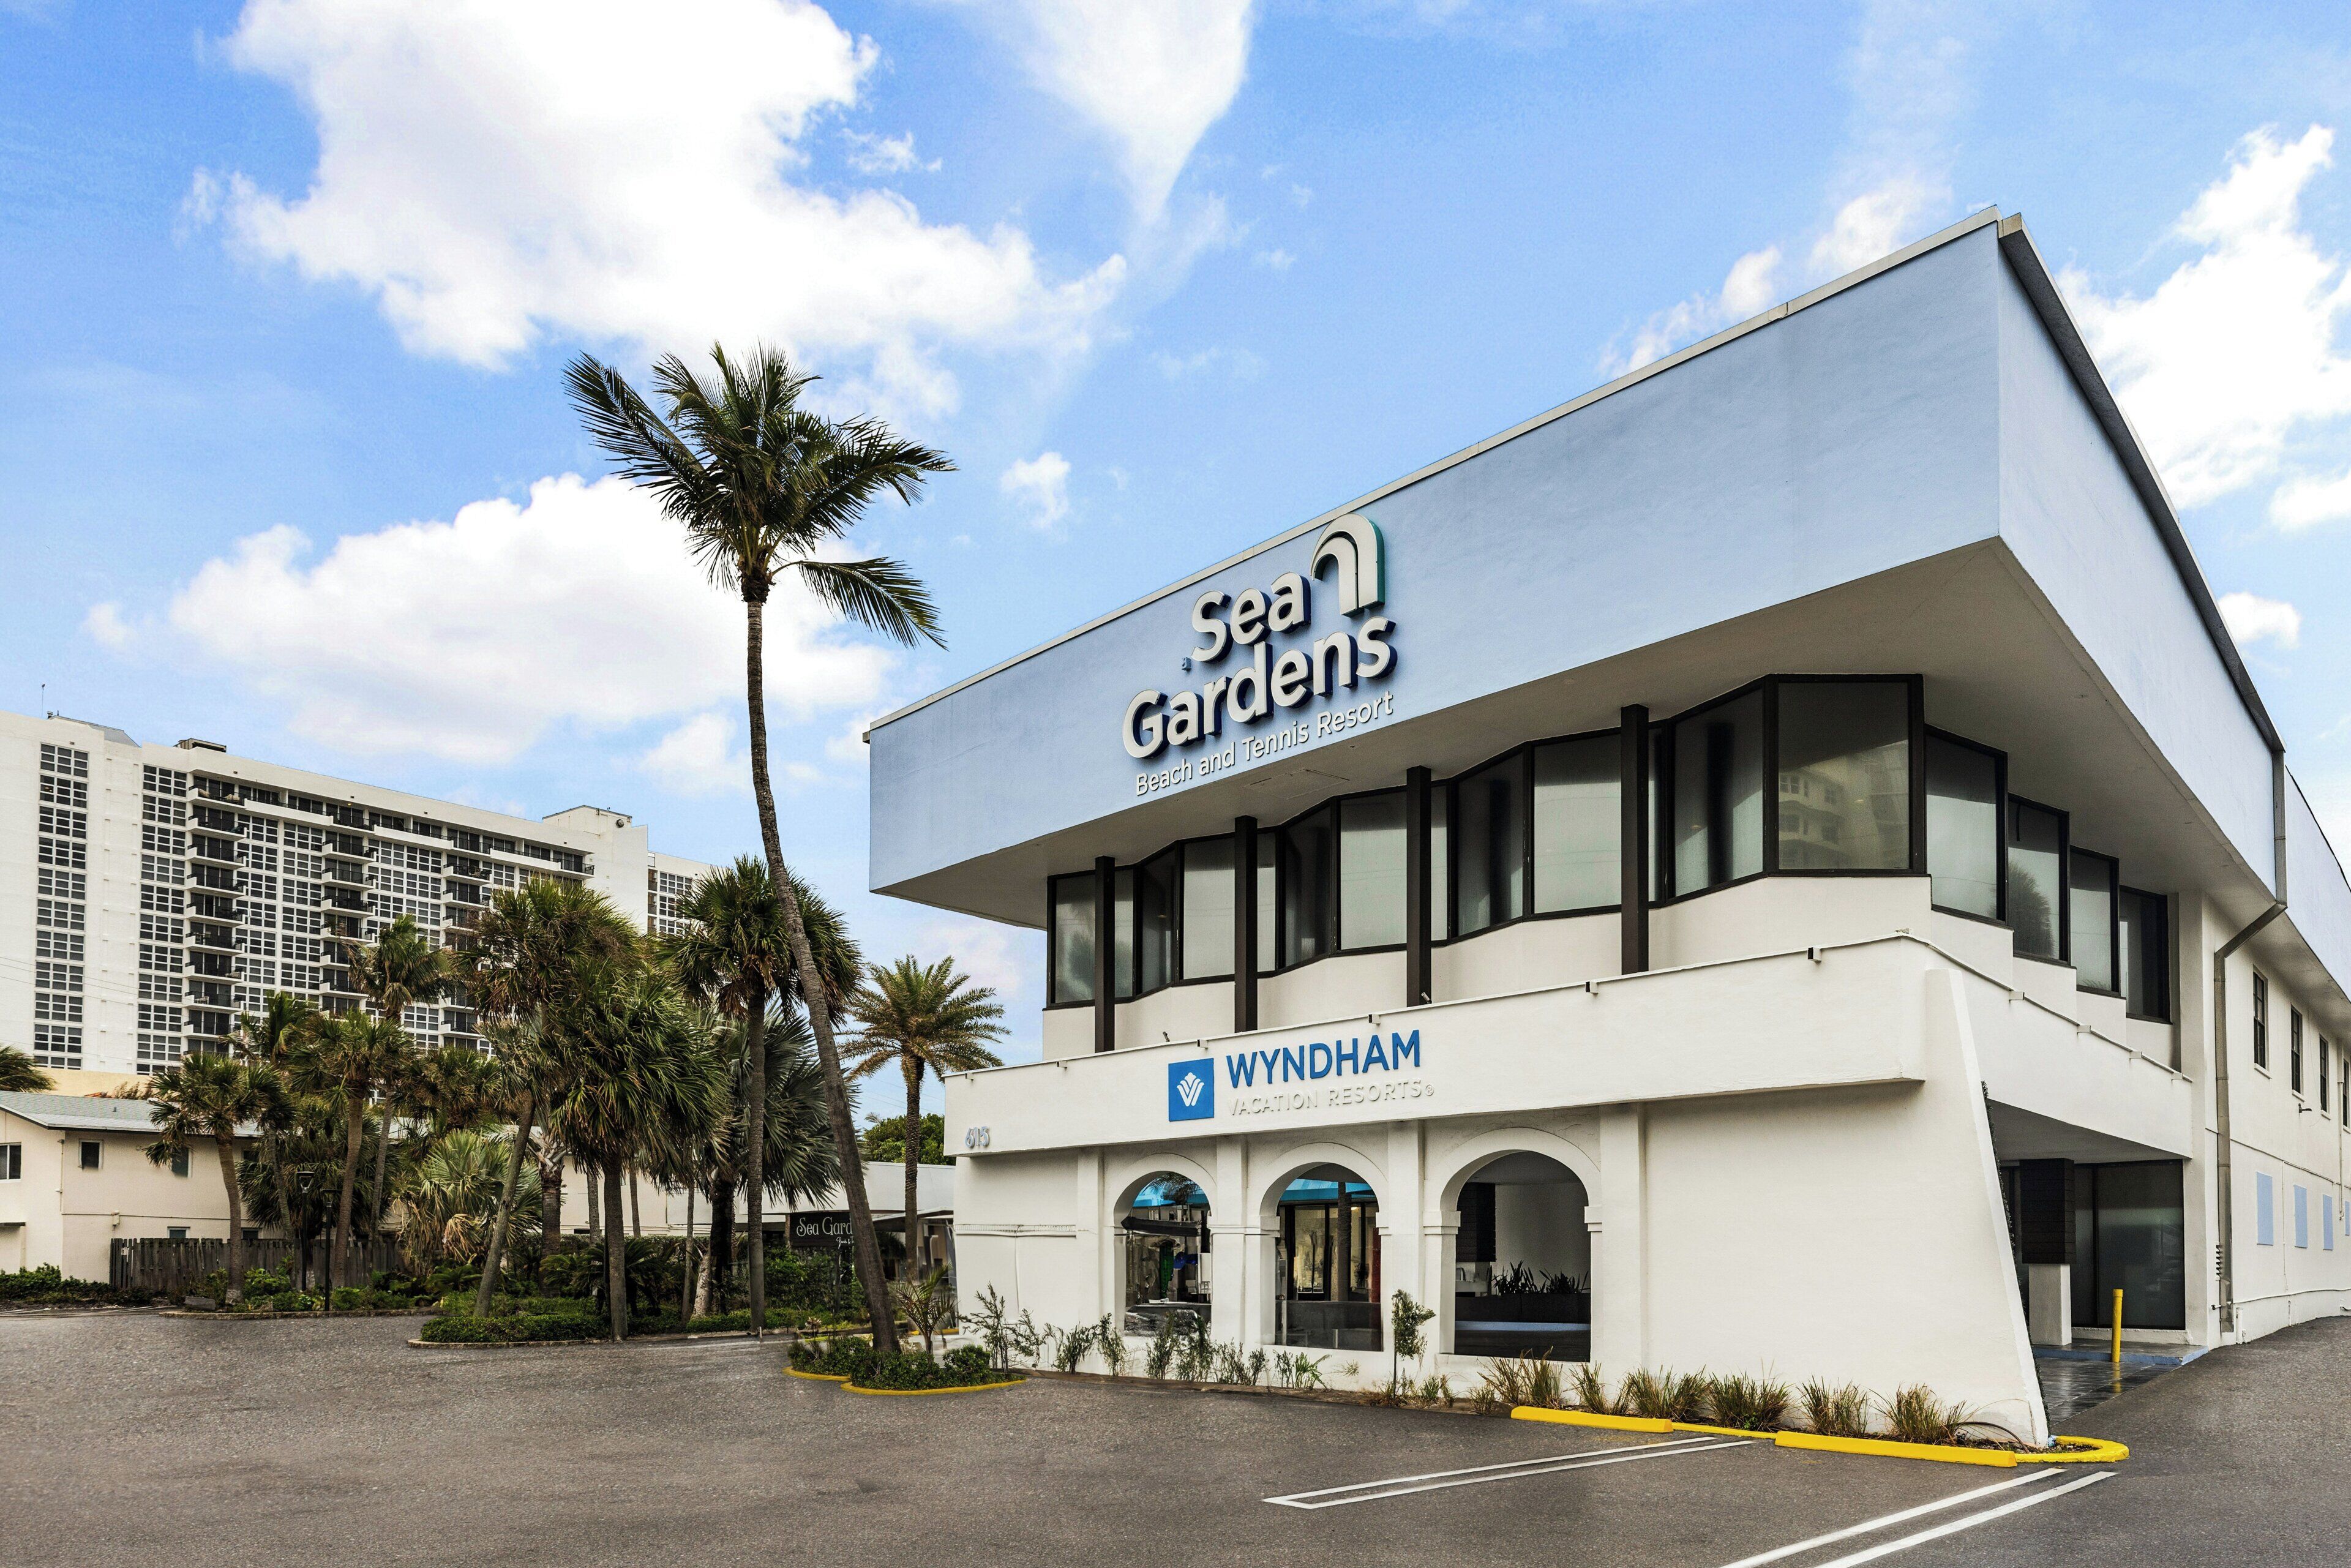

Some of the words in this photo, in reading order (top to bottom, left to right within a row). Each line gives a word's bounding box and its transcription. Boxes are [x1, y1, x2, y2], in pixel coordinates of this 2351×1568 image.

[1191, 571, 1311, 662] Sea
[1122, 616, 1398, 759] Gardens
[1136, 758, 1193, 797] Beach
[1199, 742, 1235, 776] and
[1242, 721, 1310, 762] Tennis
[1317, 690, 1395, 737] Resort
[1226, 1029, 1420, 1089] WYNDHAM
[1228, 1089, 1318, 1116] VACATION
[965, 1126, 990, 1149] 615
[796, 1217, 819, 1237] Sea
[822, 1217, 853, 1236] Gard
